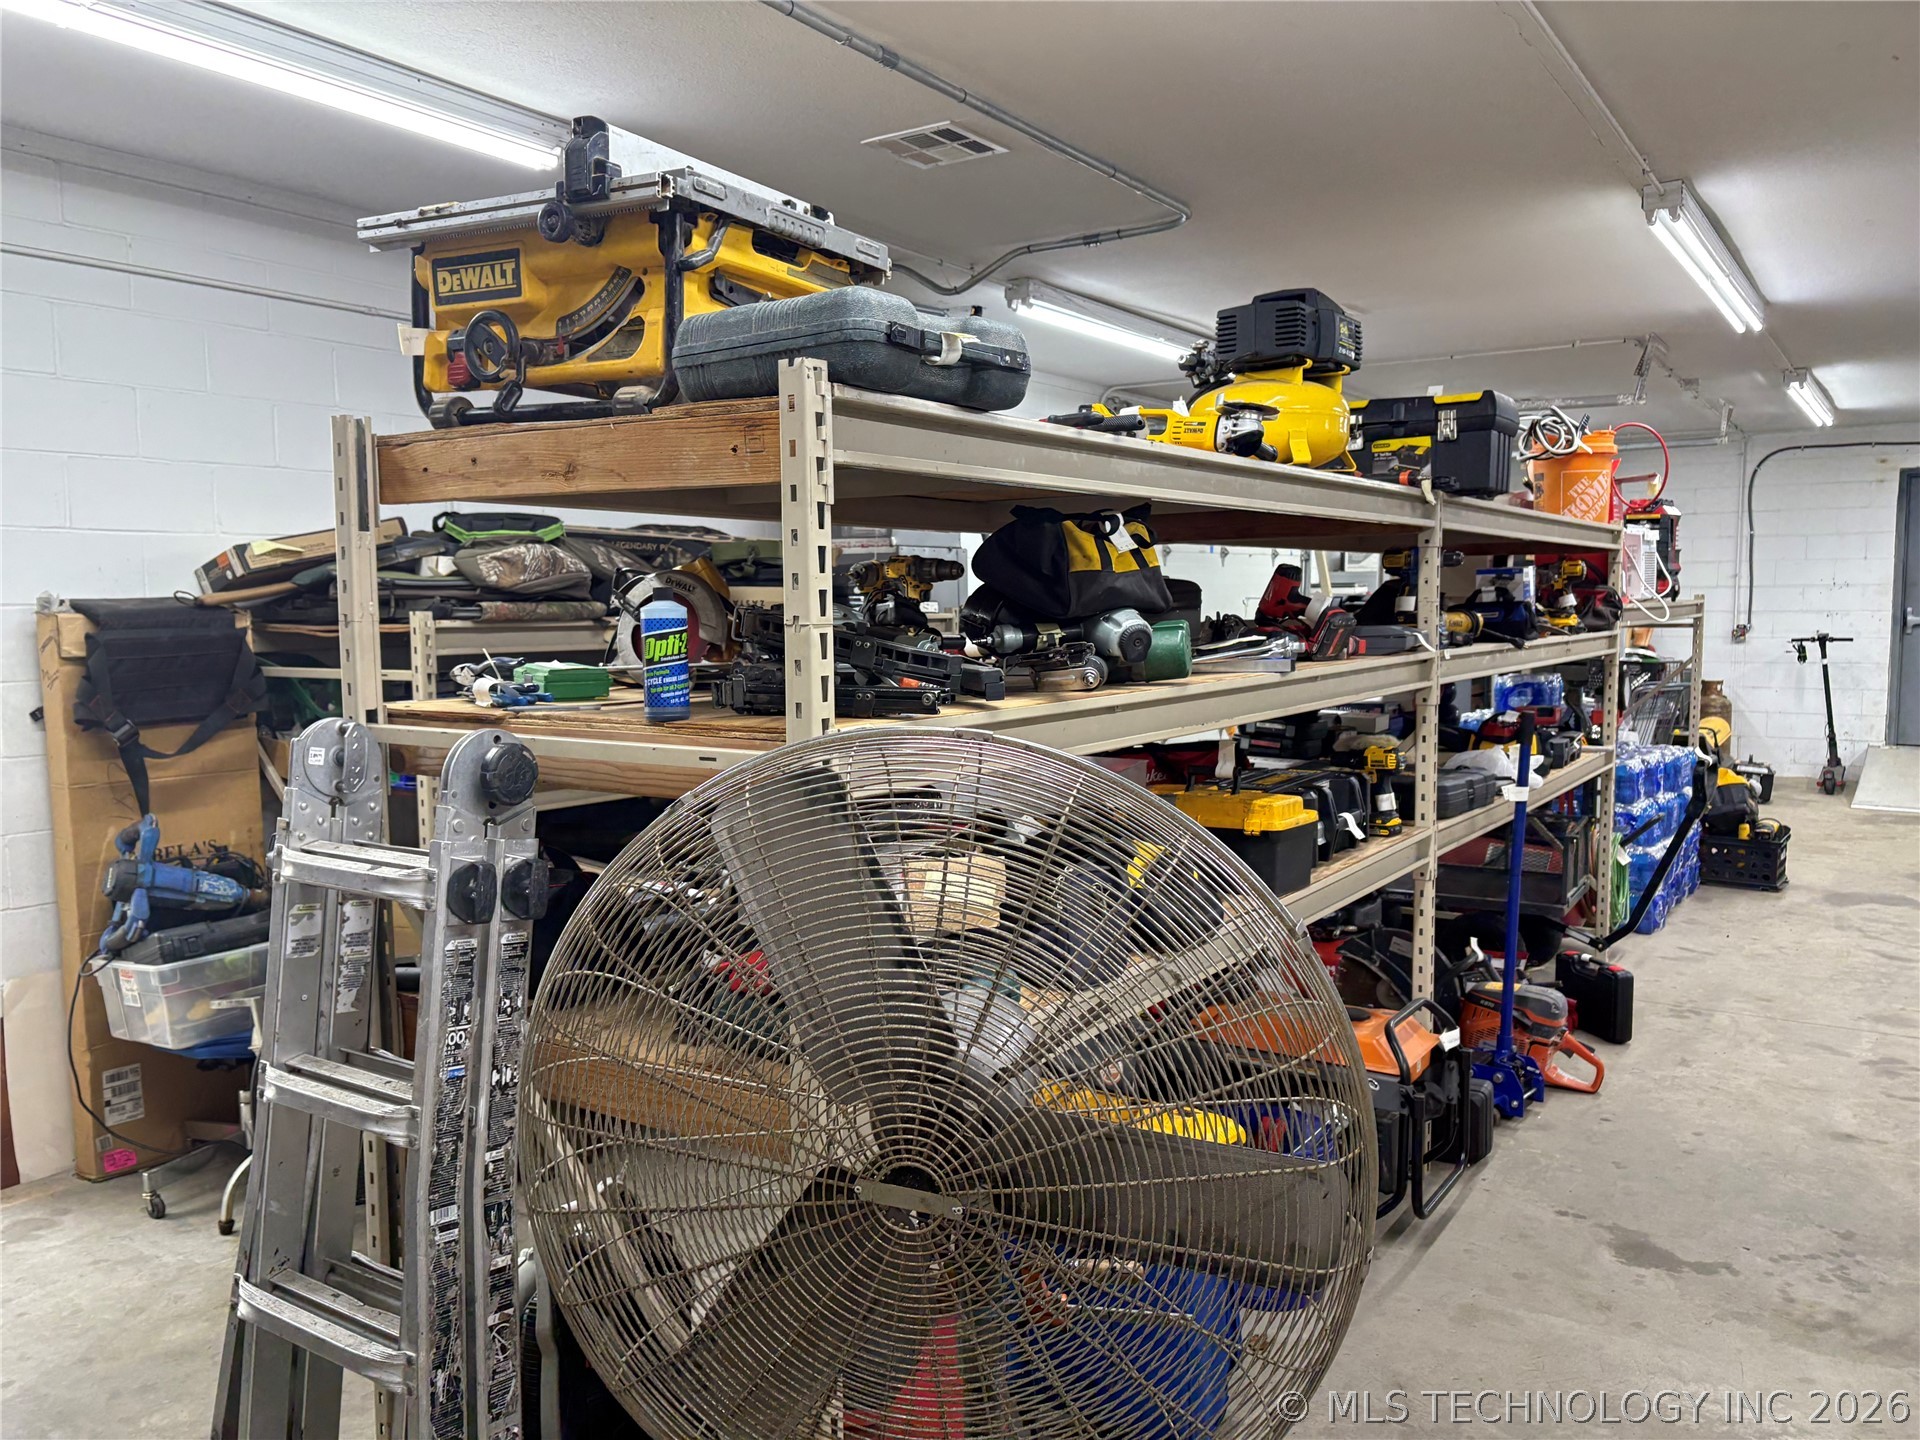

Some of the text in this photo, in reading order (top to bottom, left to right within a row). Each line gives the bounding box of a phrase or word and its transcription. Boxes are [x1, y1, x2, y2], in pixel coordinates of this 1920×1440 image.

[437, 263, 516, 293] DEWALT
[1568, 476, 1592, 498] THE
[645, 632, 688, 662] Opti-2
